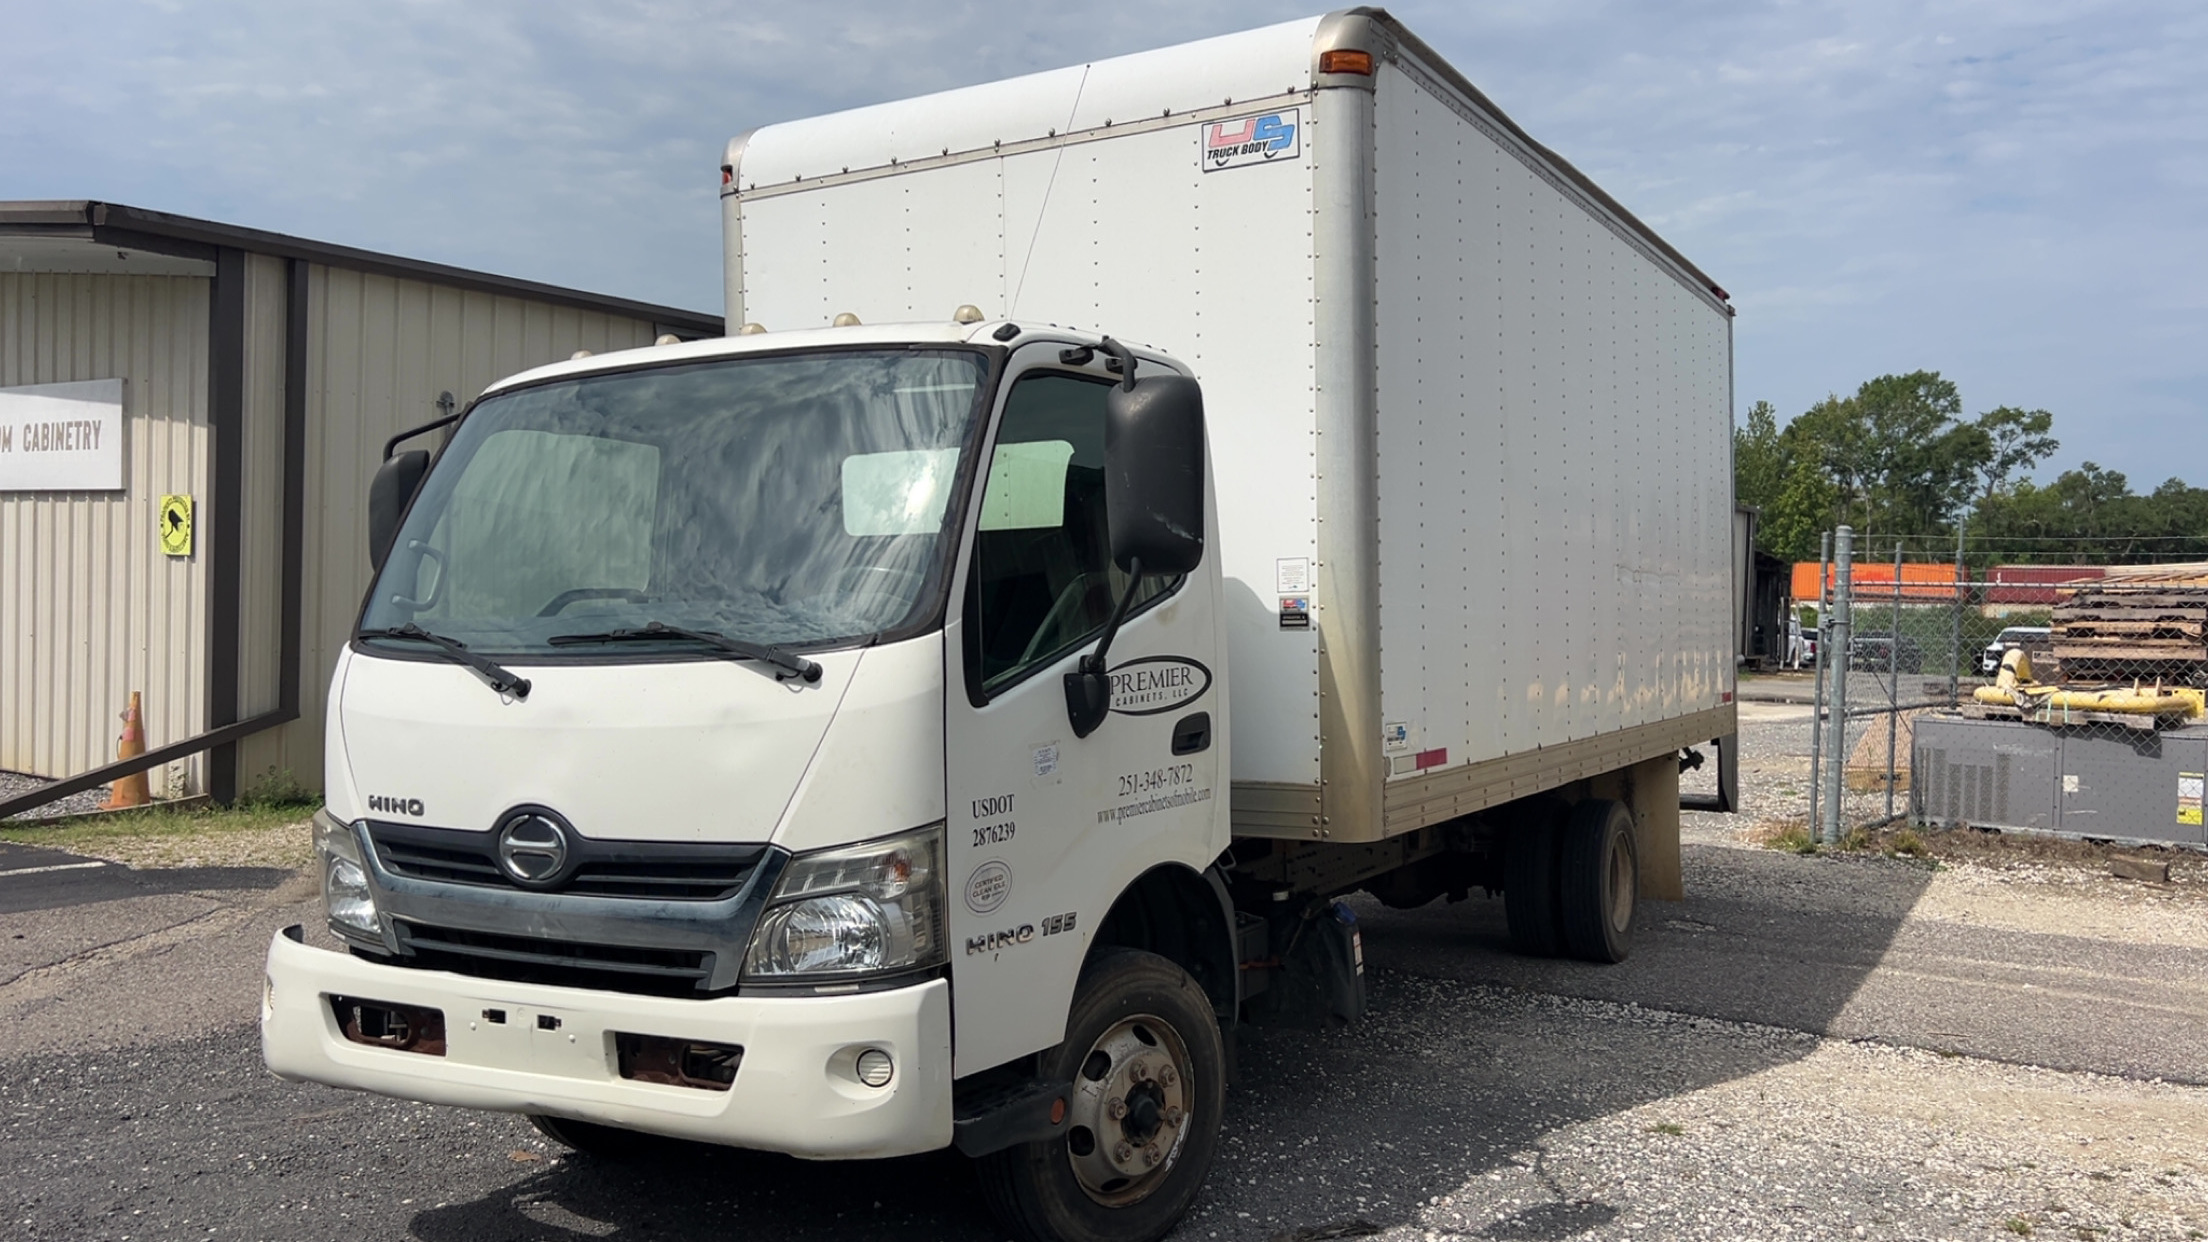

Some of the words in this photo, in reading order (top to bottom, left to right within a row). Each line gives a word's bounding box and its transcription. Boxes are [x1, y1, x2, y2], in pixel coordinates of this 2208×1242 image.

[1208, 115, 1295, 151] US
[1207, 145, 1240, 160] TRUCK
[1241, 140, 1269, 155] BODY
[22, 419, 102, 452] CABINETRY
[1109, 666, 1194, 695] PREMIER
[1172, 687, 1189, 698] LLC
[1118, 763, 1193, 797] 251-348-7872
[368, 794, 425, 817] HINO
[972, 793, 1015, 819] USDOT
[1097, 787, 1212, 826] www.premiercabinetsofmobile.com
[972, 821, 1016, 848] 2876239
[965, 923, 1035, 956] HINO
[1041, 911, 1078, 937] 155
